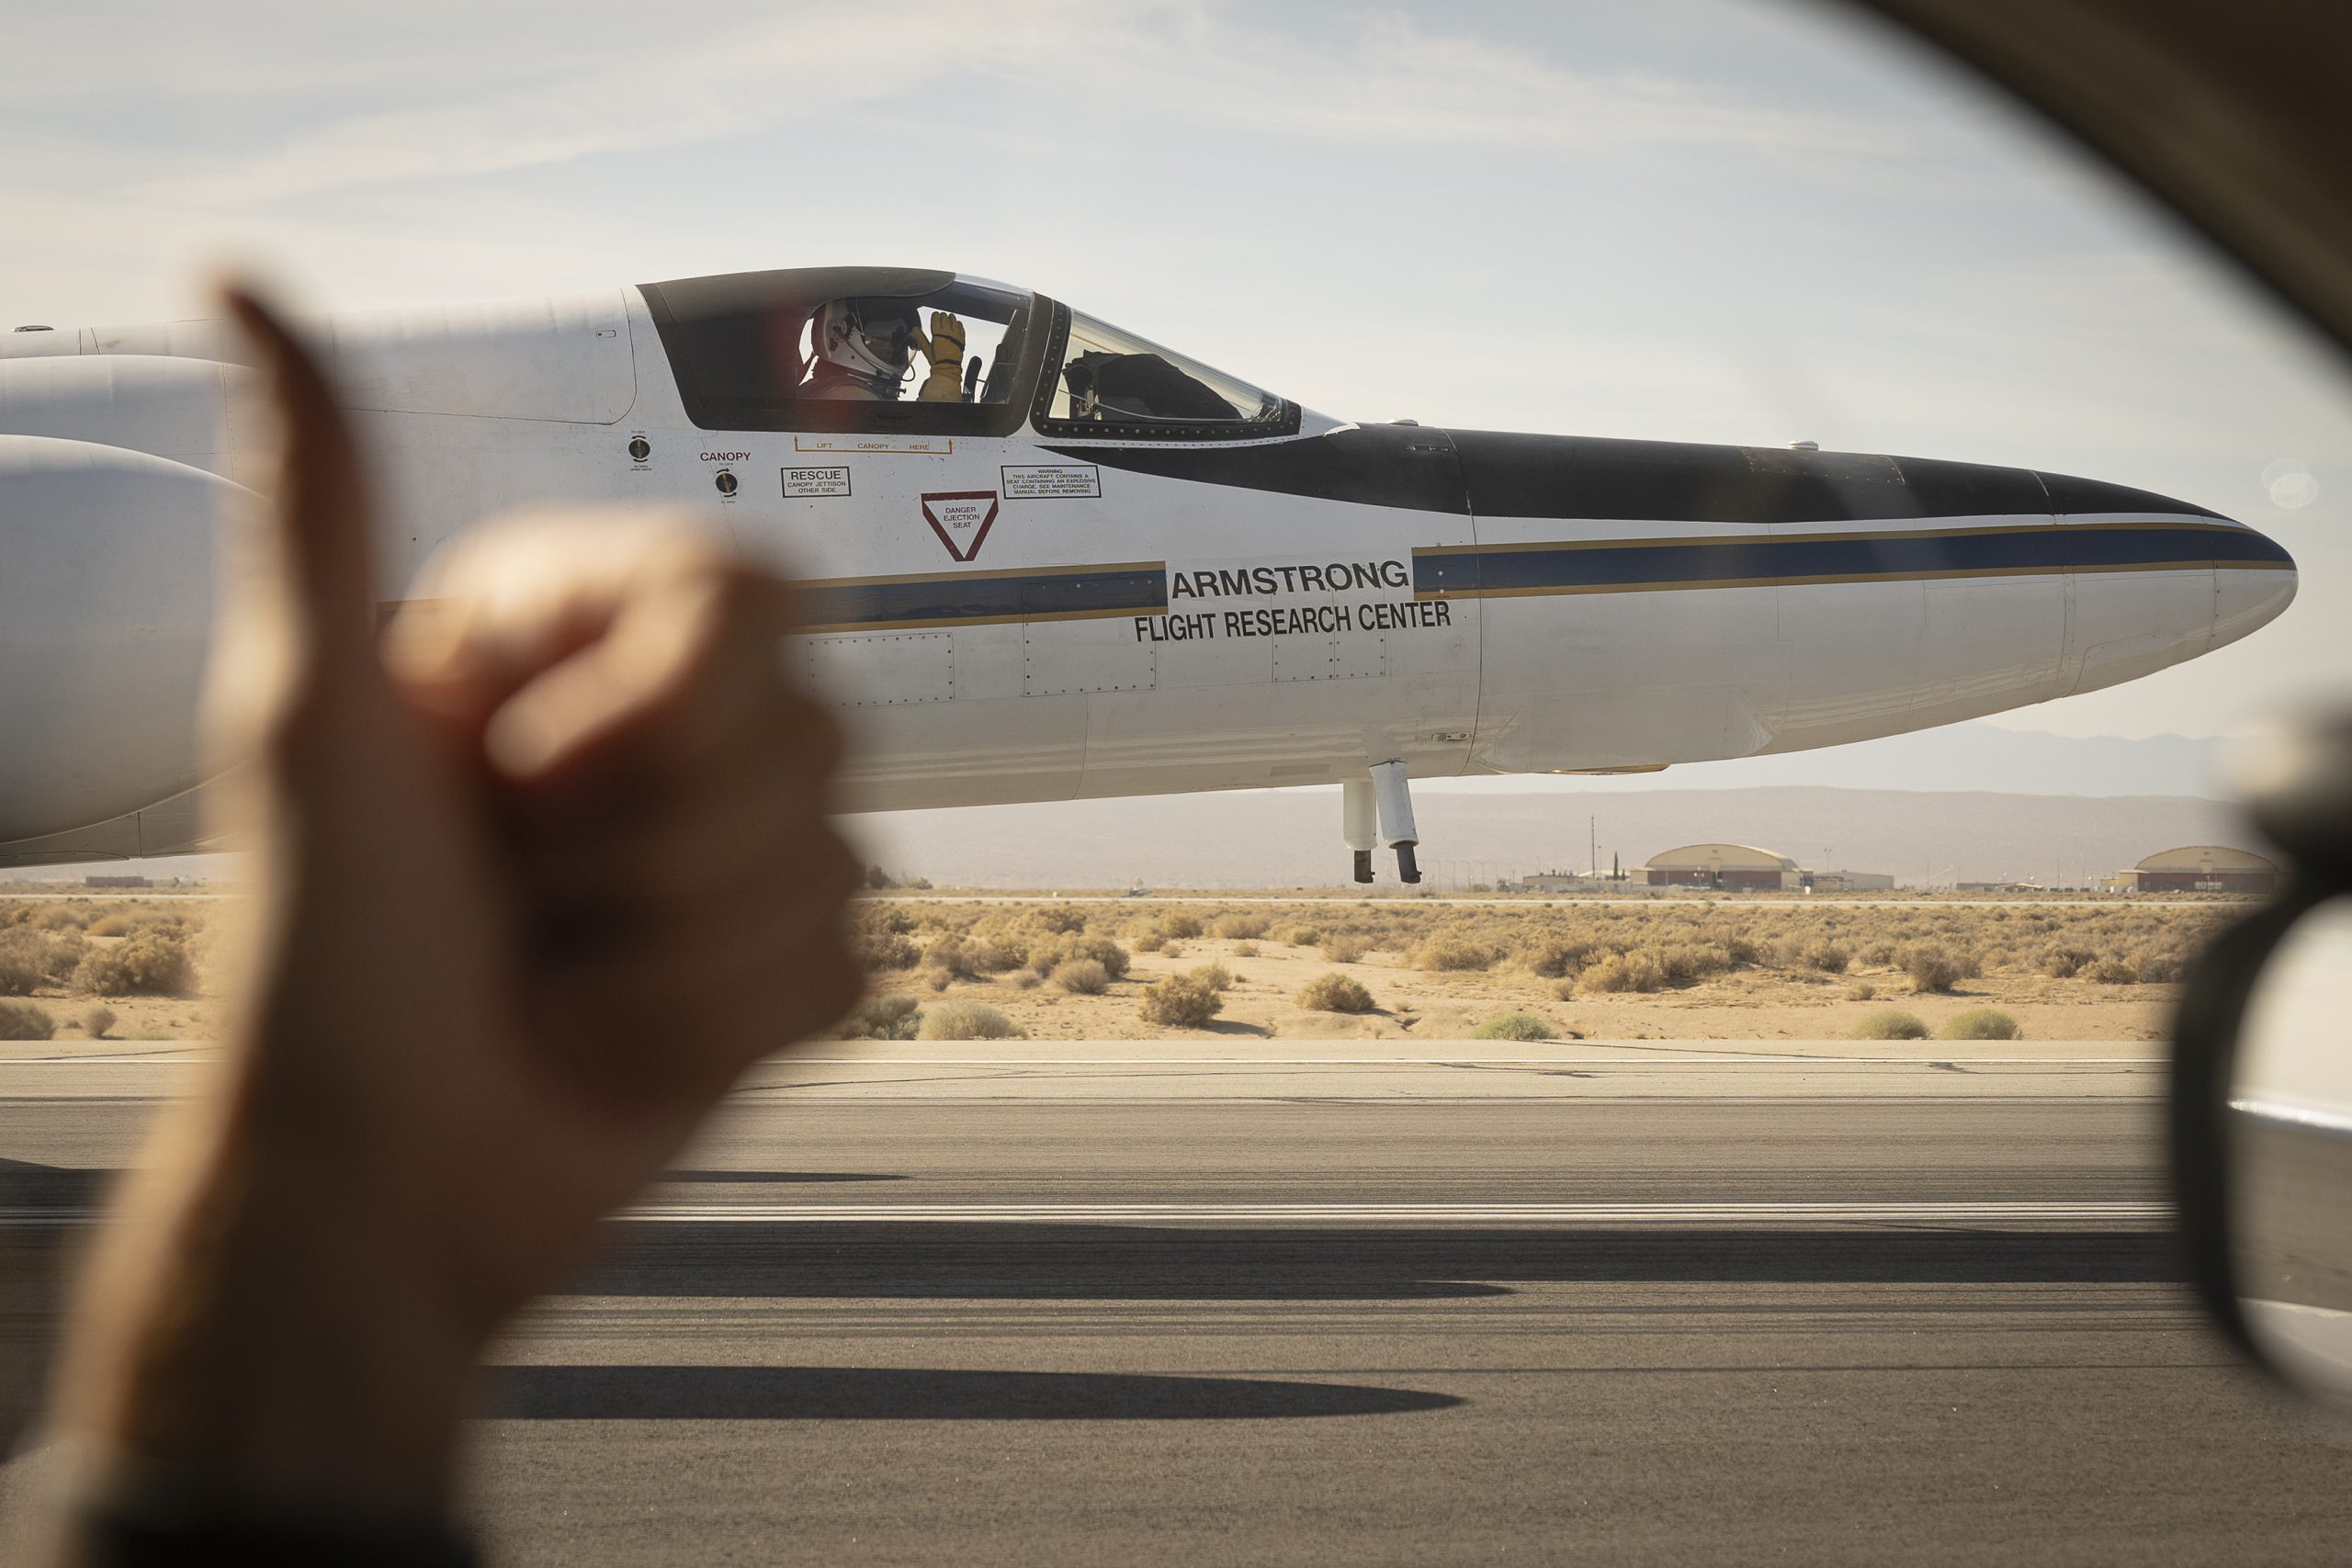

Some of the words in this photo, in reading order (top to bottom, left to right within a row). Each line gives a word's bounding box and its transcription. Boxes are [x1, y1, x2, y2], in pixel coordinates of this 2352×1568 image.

[700, 452, 751, 461] CANOPY
[790, 470, 842, 480] RESCUE
[943, 513, 980, 522] EJECTION
[1171, 560, 1409, 599] ARMSTRONG
[1135, 613, 1216, 642] FLIGHT
[1225, 605, 1351, 637] RESEARCH
[1359, 601, 1452, 631] CENTER
